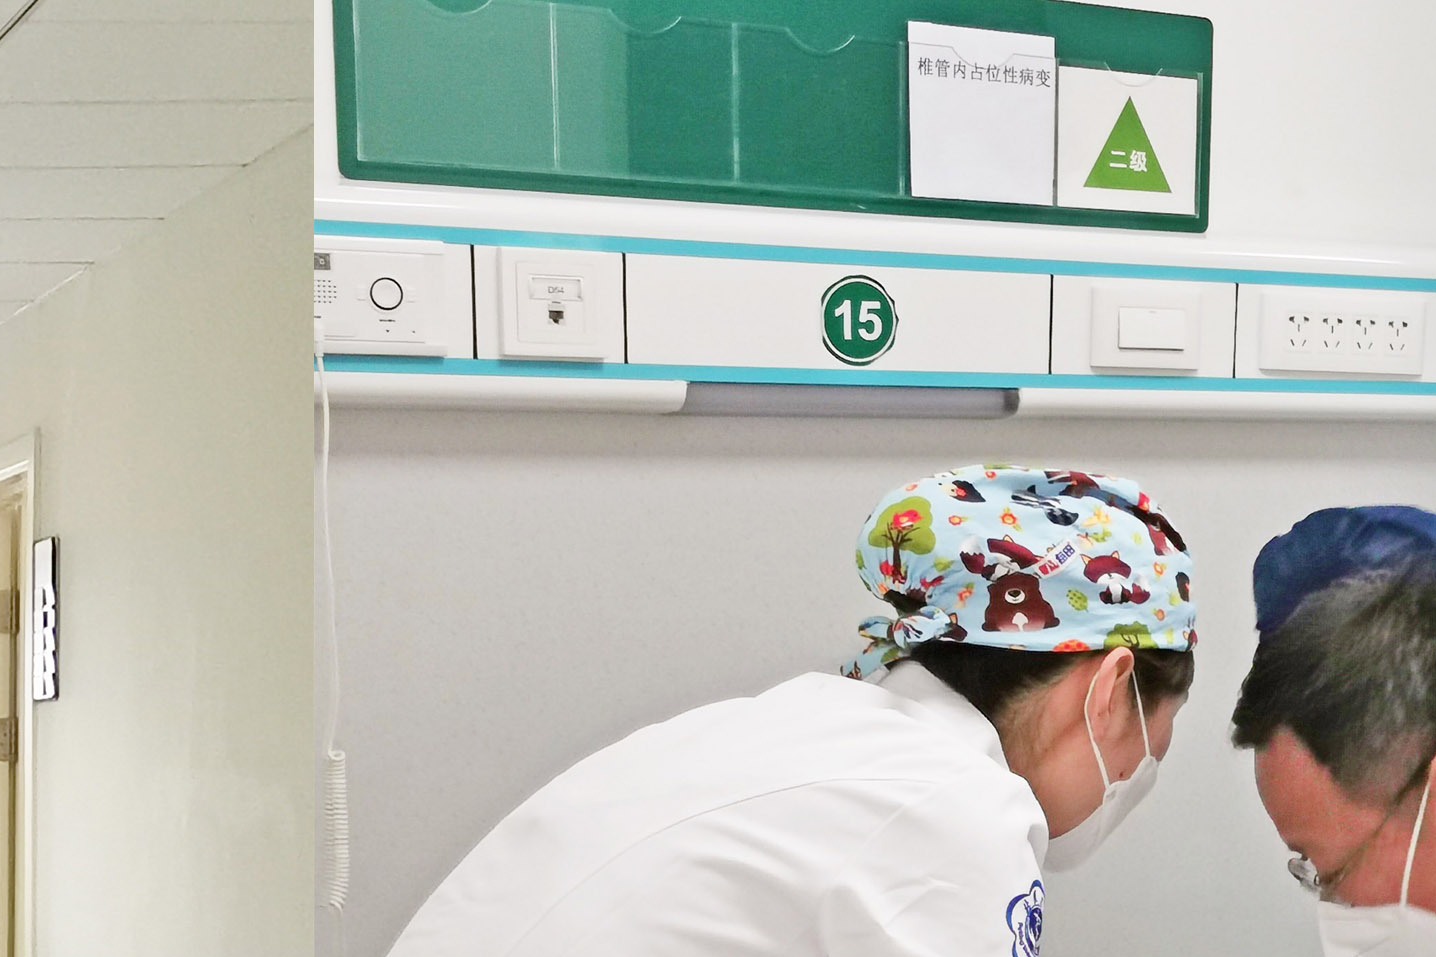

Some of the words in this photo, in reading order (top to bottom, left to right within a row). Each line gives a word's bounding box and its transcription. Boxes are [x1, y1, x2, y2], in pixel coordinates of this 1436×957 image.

[917, 57, 1051, 88] 椎管内占位性病变
[1109, 149, 1147, 173] 二级
[833, 299, 883, 342] 15
